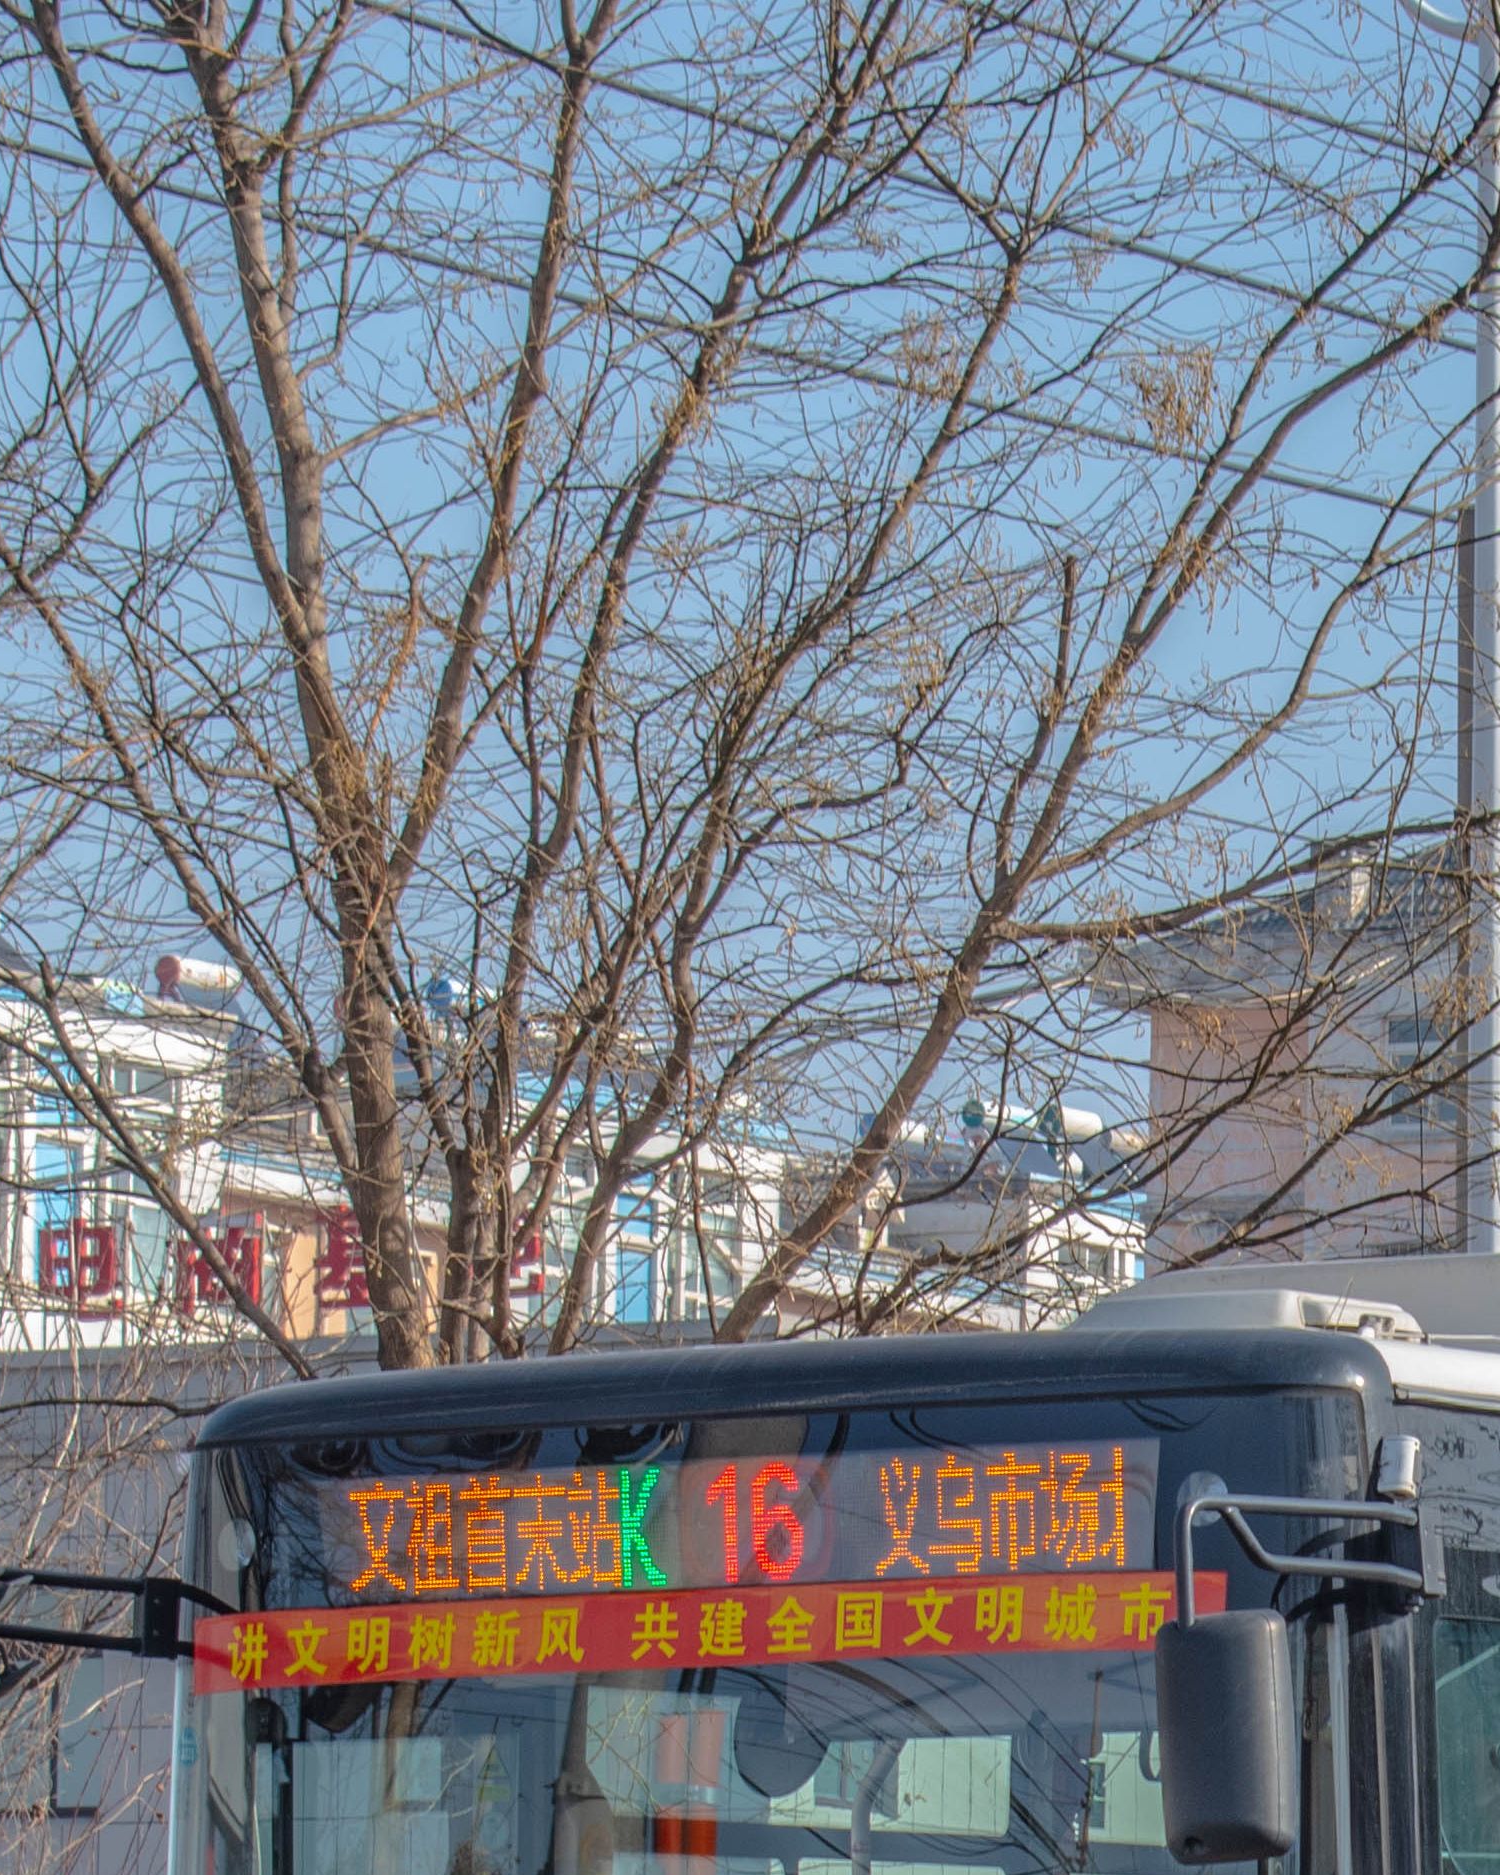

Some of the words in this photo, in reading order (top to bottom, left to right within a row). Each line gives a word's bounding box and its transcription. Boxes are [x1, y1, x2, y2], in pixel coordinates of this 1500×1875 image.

[348, 1471, 621, 1594] 文祖首末站
[620, 1466, 667, 1588] K
[705, 1460, 808, 1584] 16
[227, 1605, 585, 1682] 讲文明树新风
[630, 1581, 1172, 1662] 共建全国文明城市
